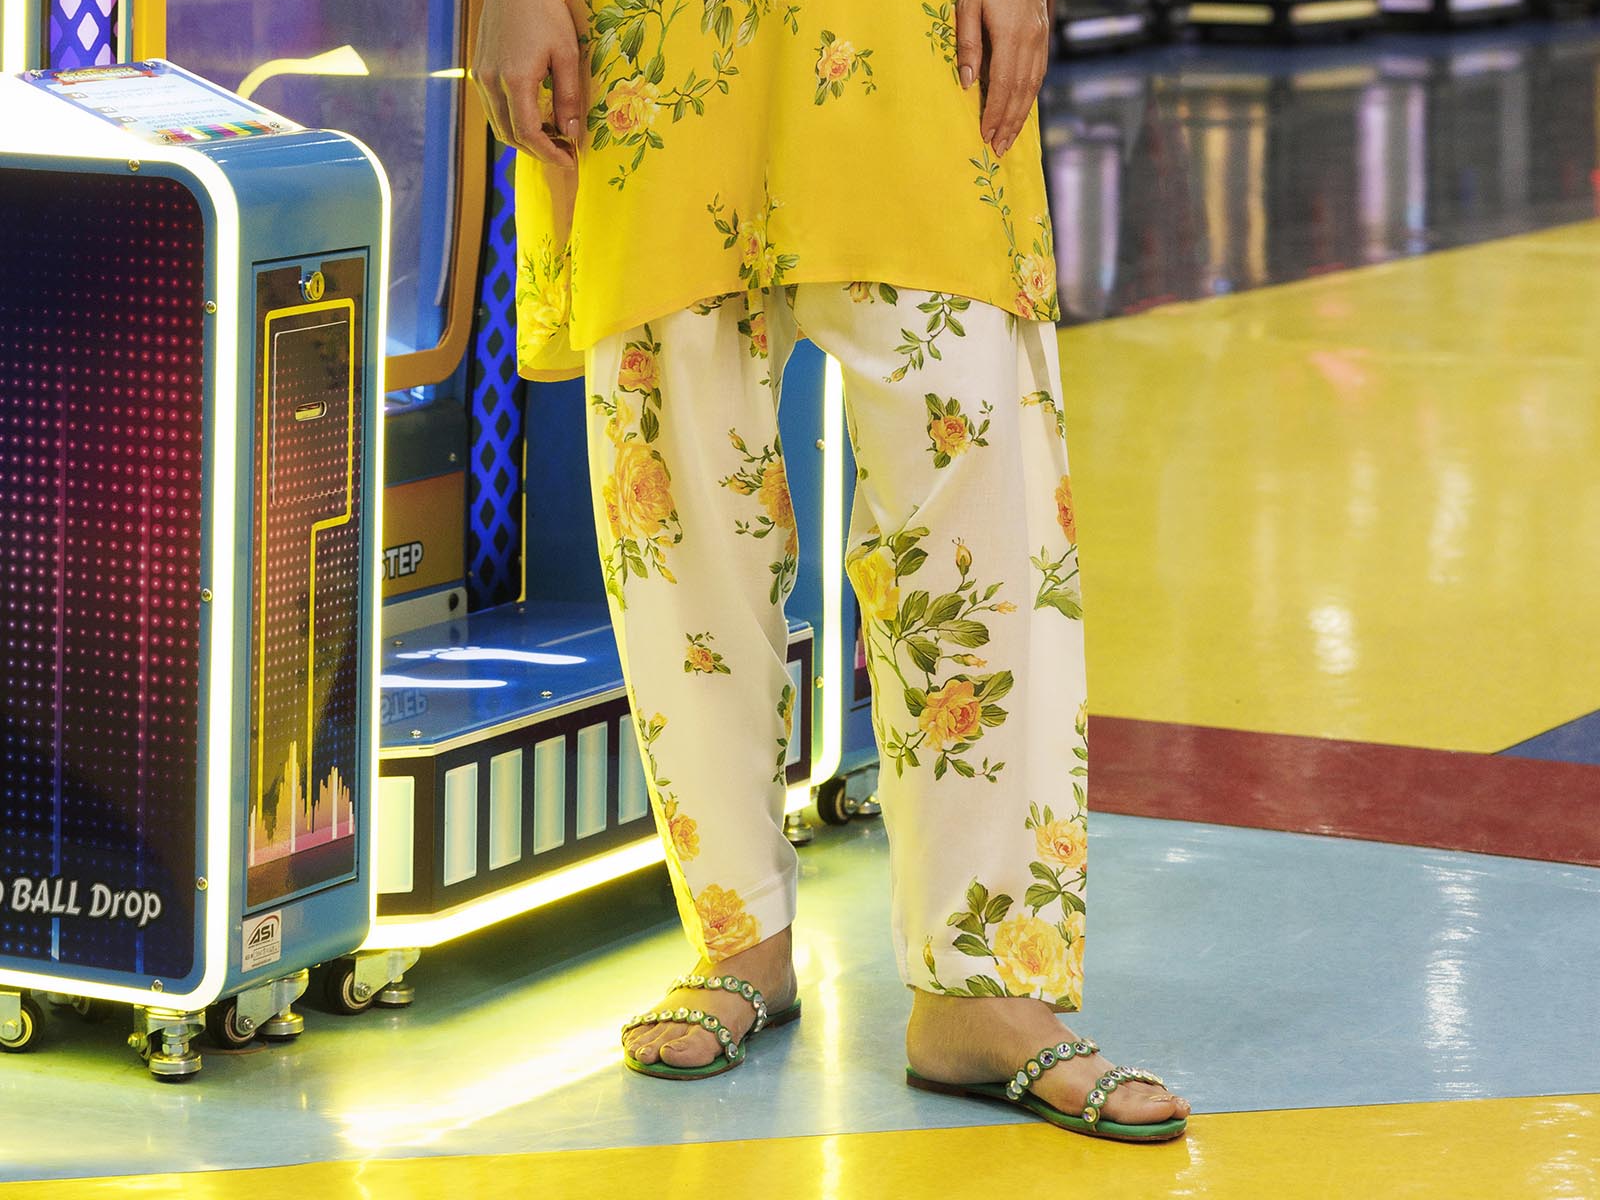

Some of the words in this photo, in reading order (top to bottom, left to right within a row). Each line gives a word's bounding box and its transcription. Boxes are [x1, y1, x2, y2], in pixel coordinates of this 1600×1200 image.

[11, 877, 82, 916] BALL
[88, 882, 161, 928] Drop
[249, 923, 275, 946] ASI
